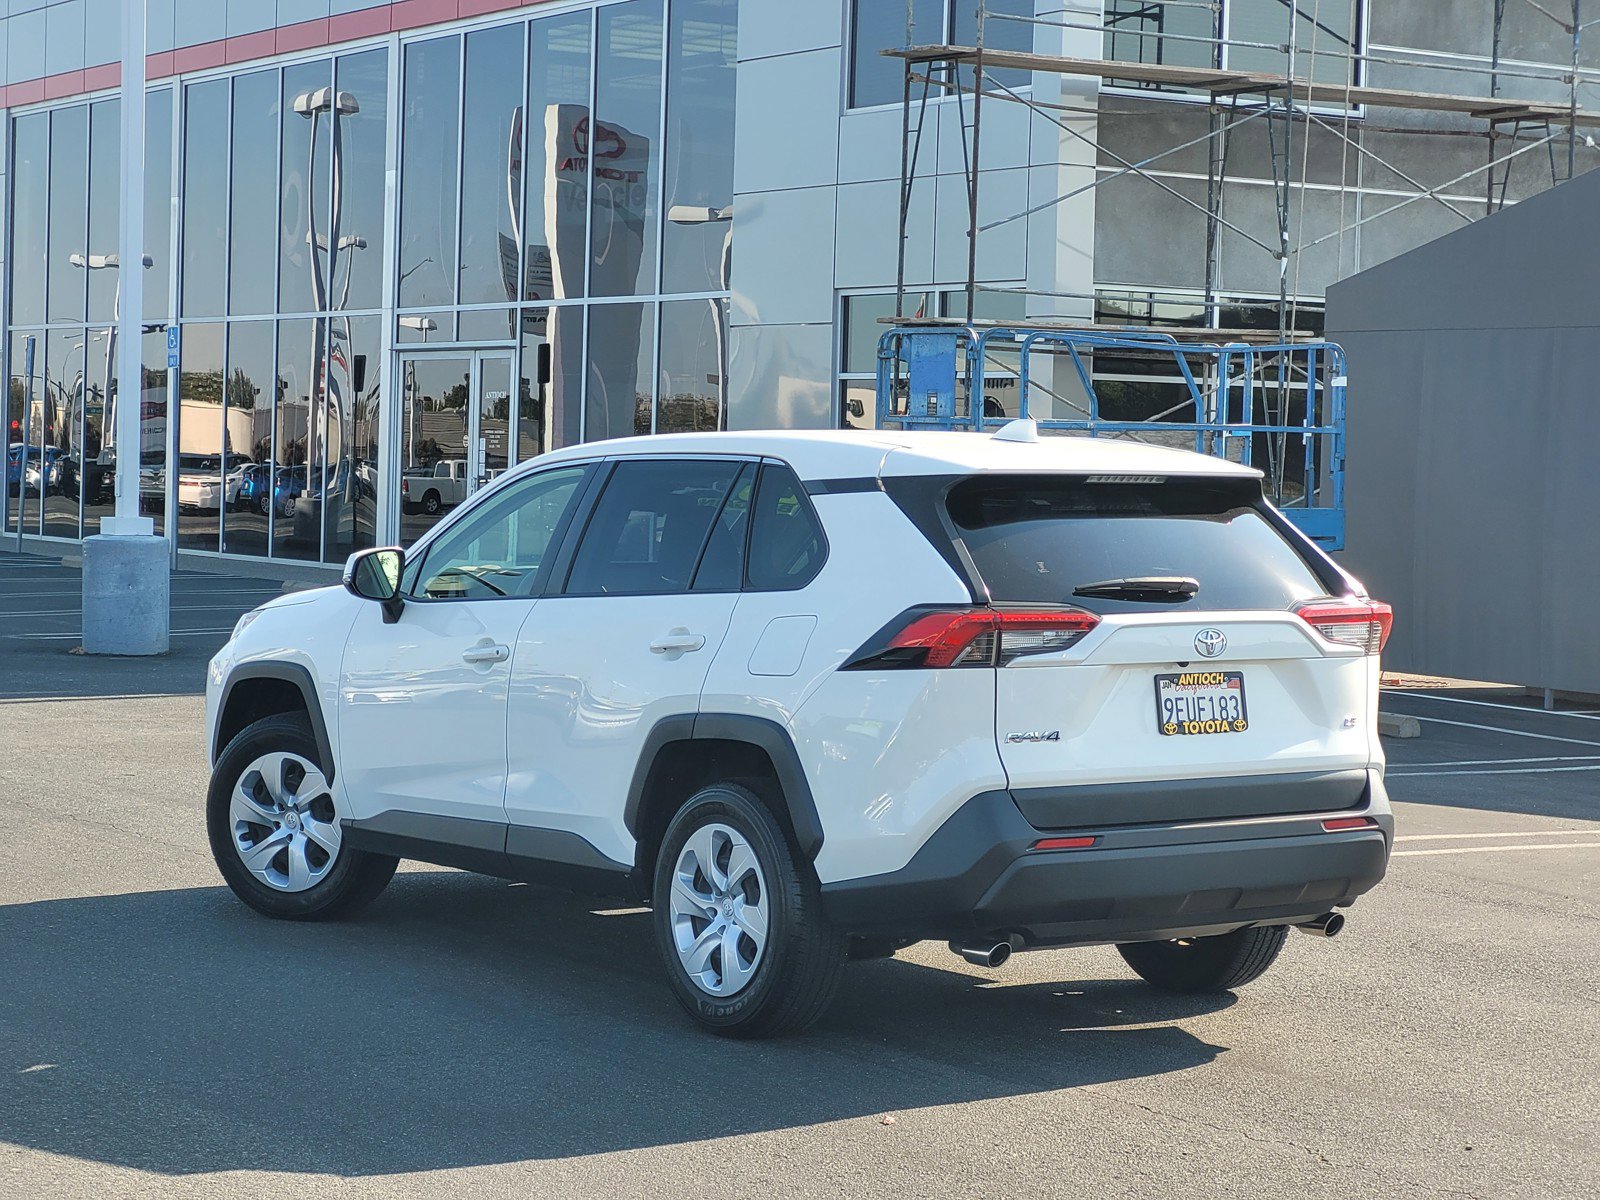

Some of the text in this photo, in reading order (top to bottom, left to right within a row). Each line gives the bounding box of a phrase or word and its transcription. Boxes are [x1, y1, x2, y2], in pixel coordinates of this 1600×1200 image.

[1178, 673, 1224, 685] ANTIOCH
[1183, 720, 1230, 734] TOYOTA
[1004, 730, 1060, 743] RAV4
